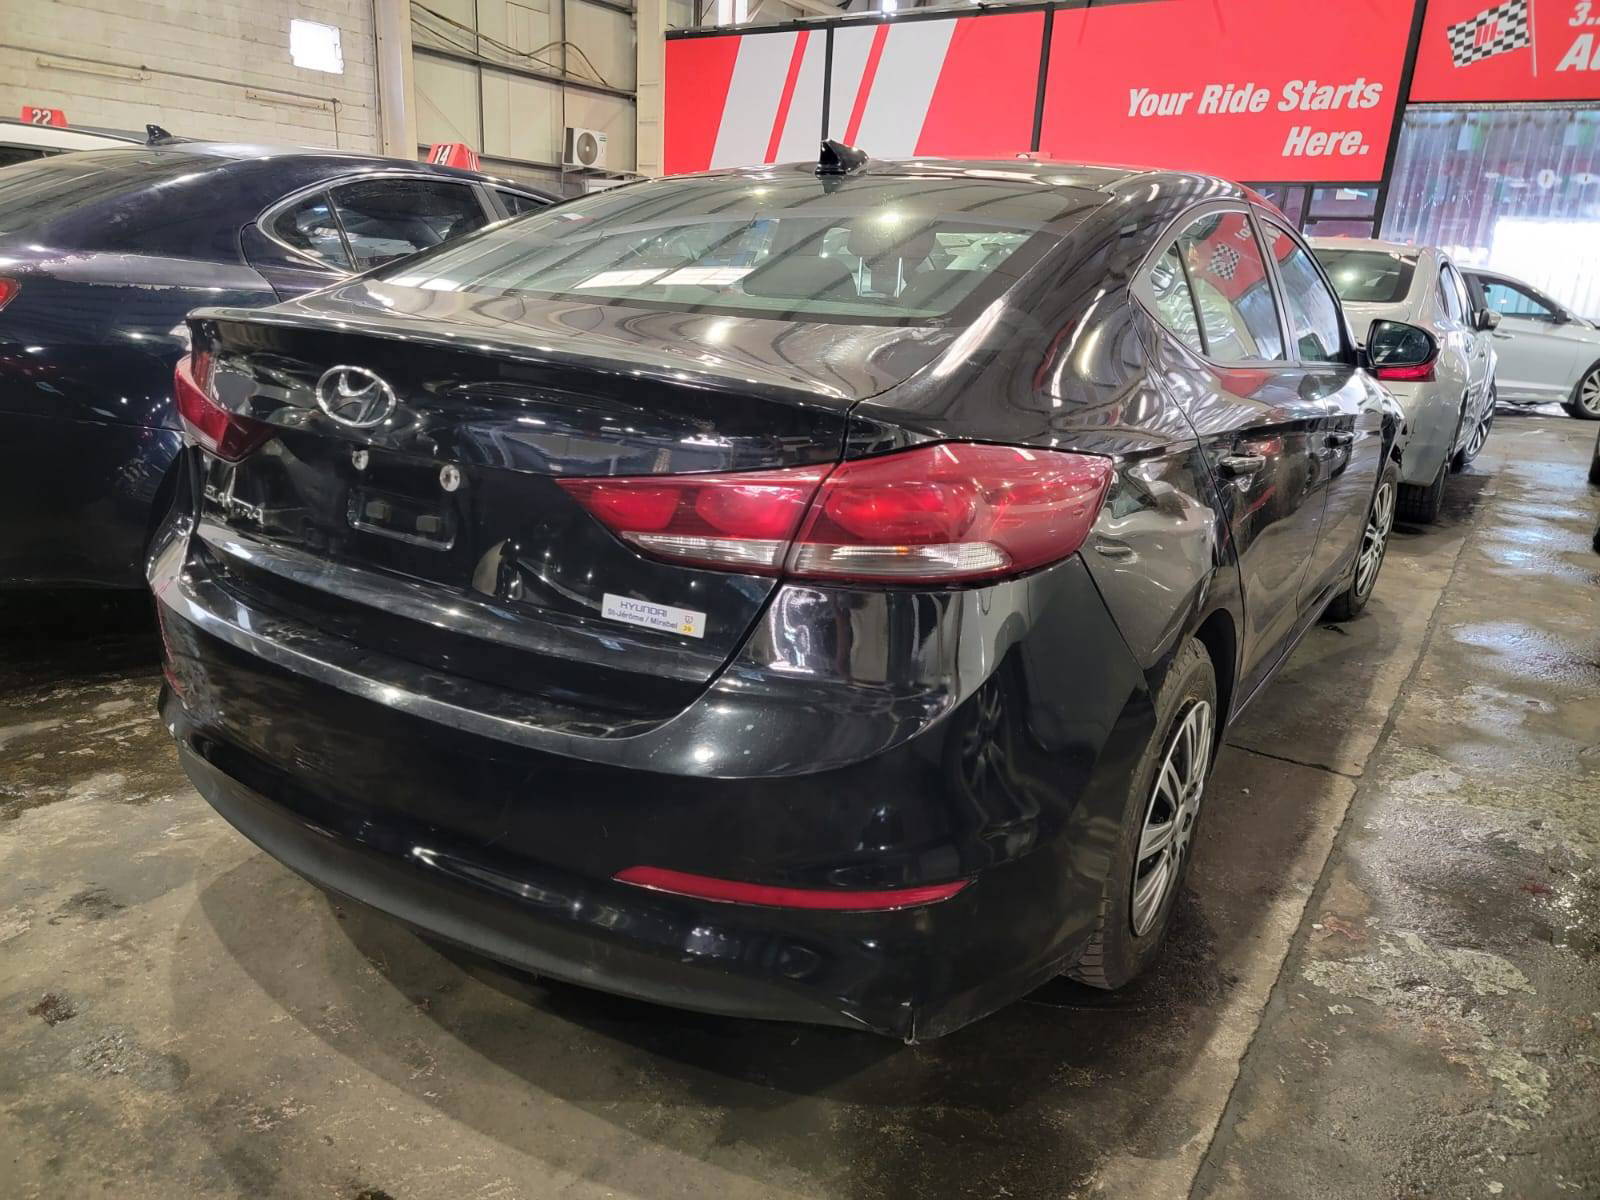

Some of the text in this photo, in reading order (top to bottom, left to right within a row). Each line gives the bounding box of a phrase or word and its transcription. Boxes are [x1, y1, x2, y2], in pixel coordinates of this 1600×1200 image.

[1128, 77, 1383, 117] Your Ride Starts
[32, 109, 52, 126] 22
[1281, 125, 1370, 157] Here.
[434, 144, 451, 165] 14
[620, 601, 668, 617] HYUNDAI
